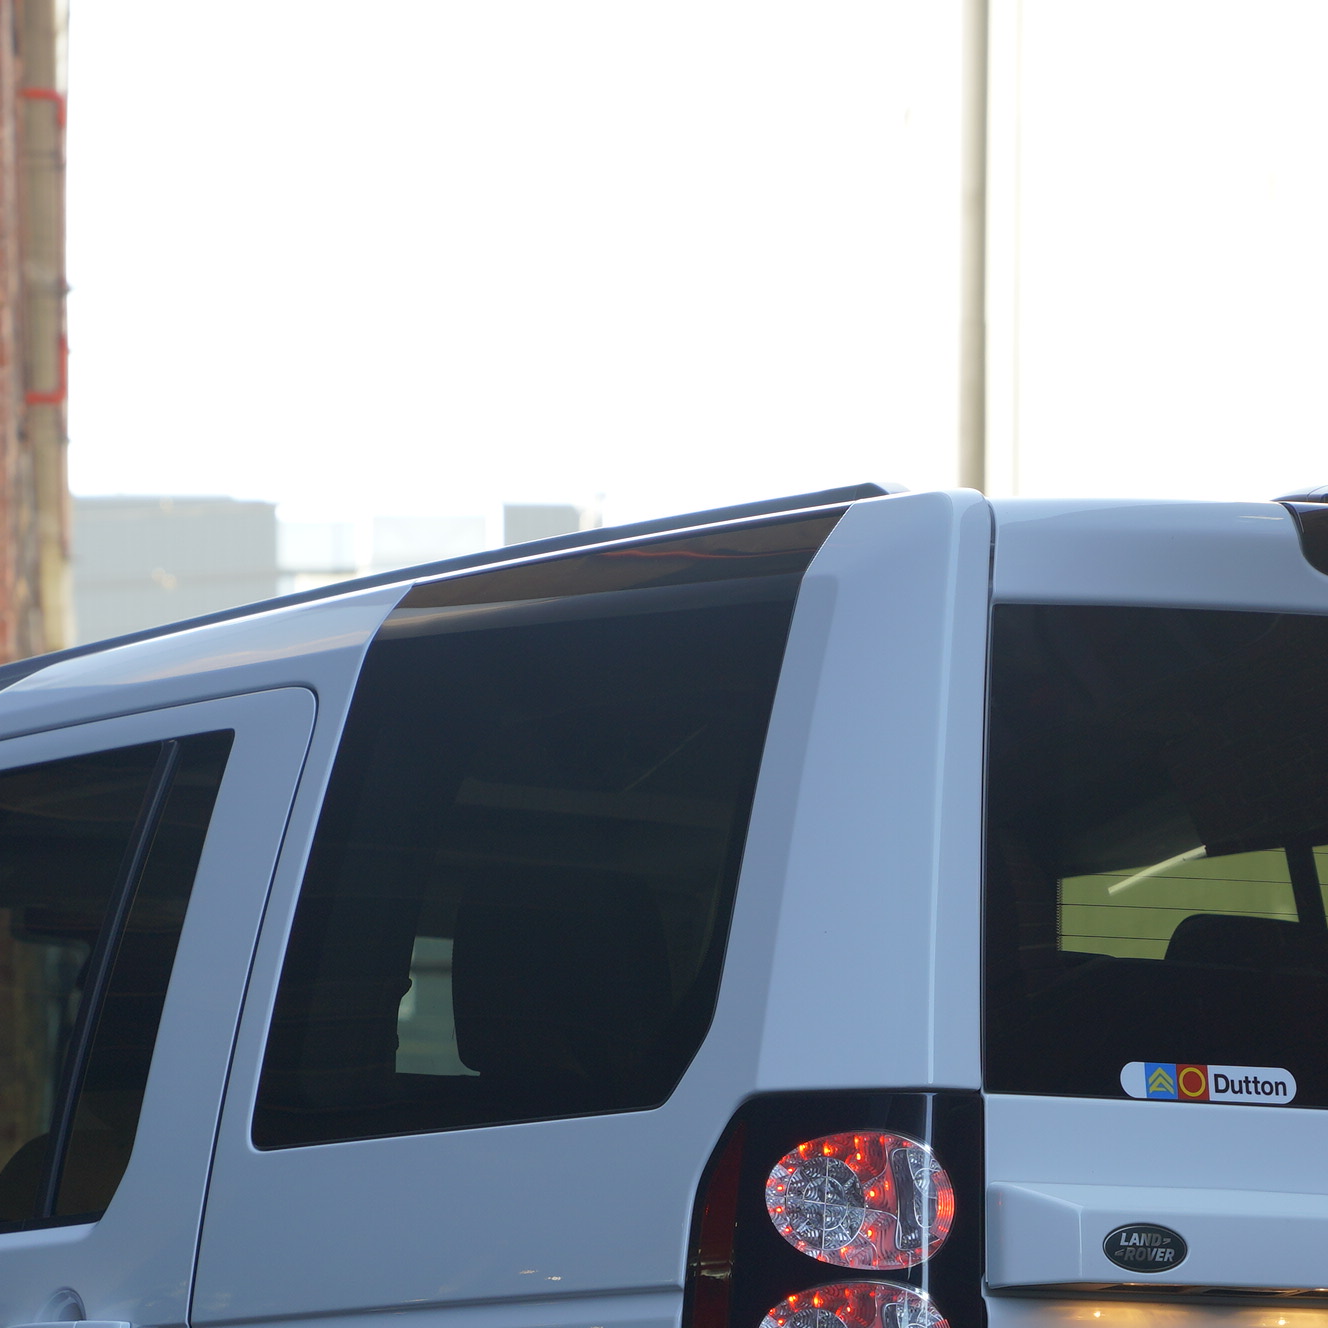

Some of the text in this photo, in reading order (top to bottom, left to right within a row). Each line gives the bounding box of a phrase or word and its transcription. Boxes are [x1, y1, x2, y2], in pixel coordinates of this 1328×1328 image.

[1213, 1073, 1287, 1096] Dutton
[1120, 1233, 1162, 1247] LAND
[1124, 1247, 1175, 1262] ROVER
